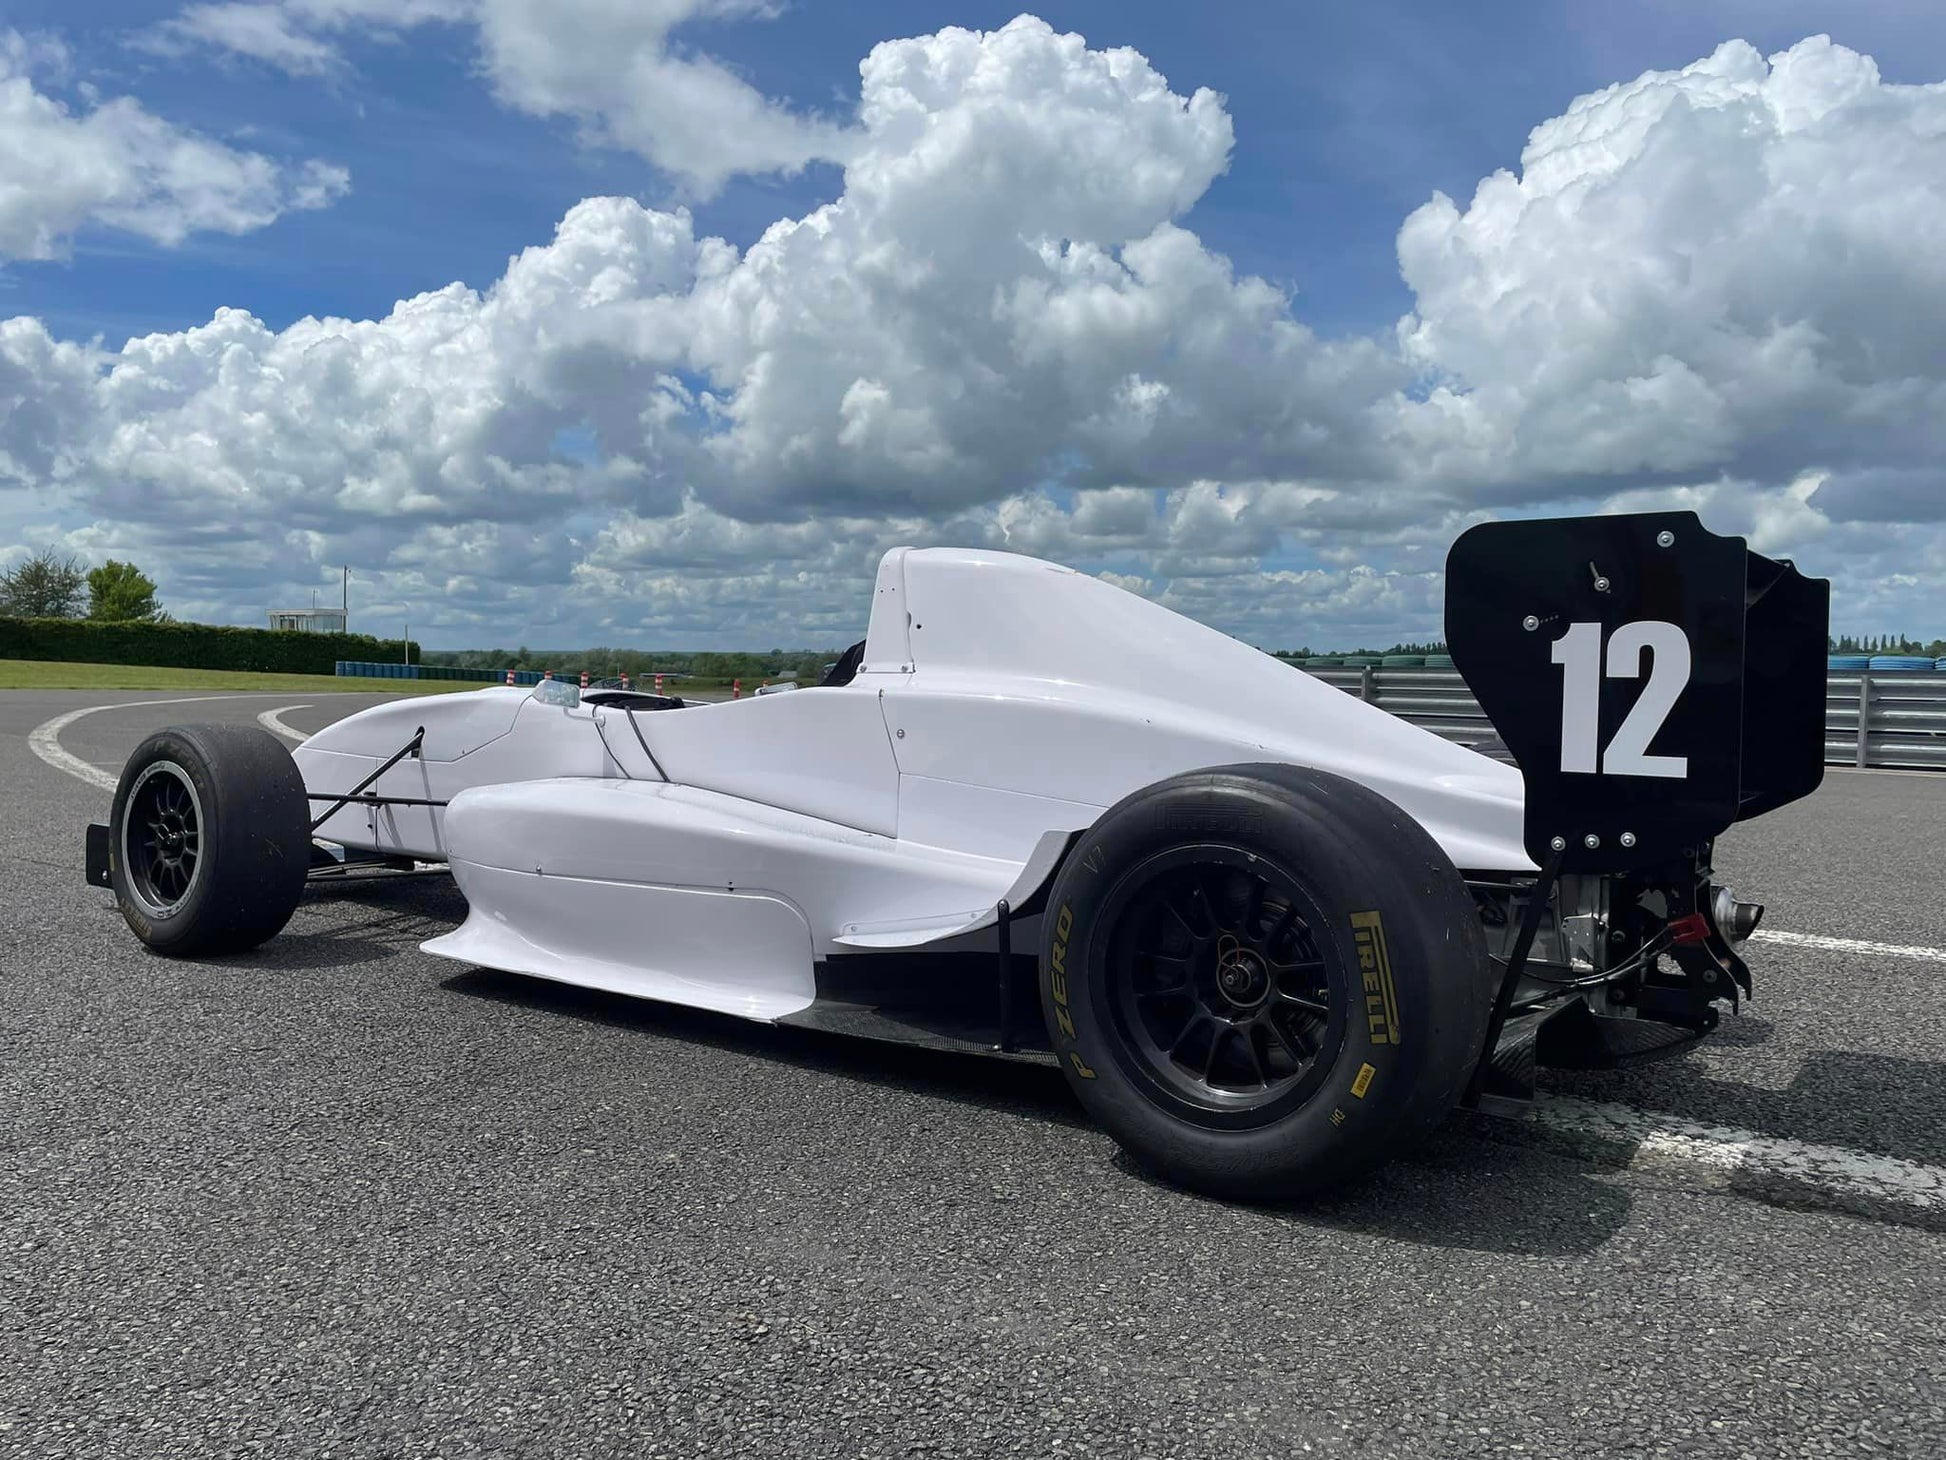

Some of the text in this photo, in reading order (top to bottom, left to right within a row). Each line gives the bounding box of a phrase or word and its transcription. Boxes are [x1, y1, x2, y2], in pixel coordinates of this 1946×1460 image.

[1551, 620, 1691, 778] 12
[1050, 904, 1097, 1080] P ZERO
[1350, 911, 1400, 1044] PIRELLI
